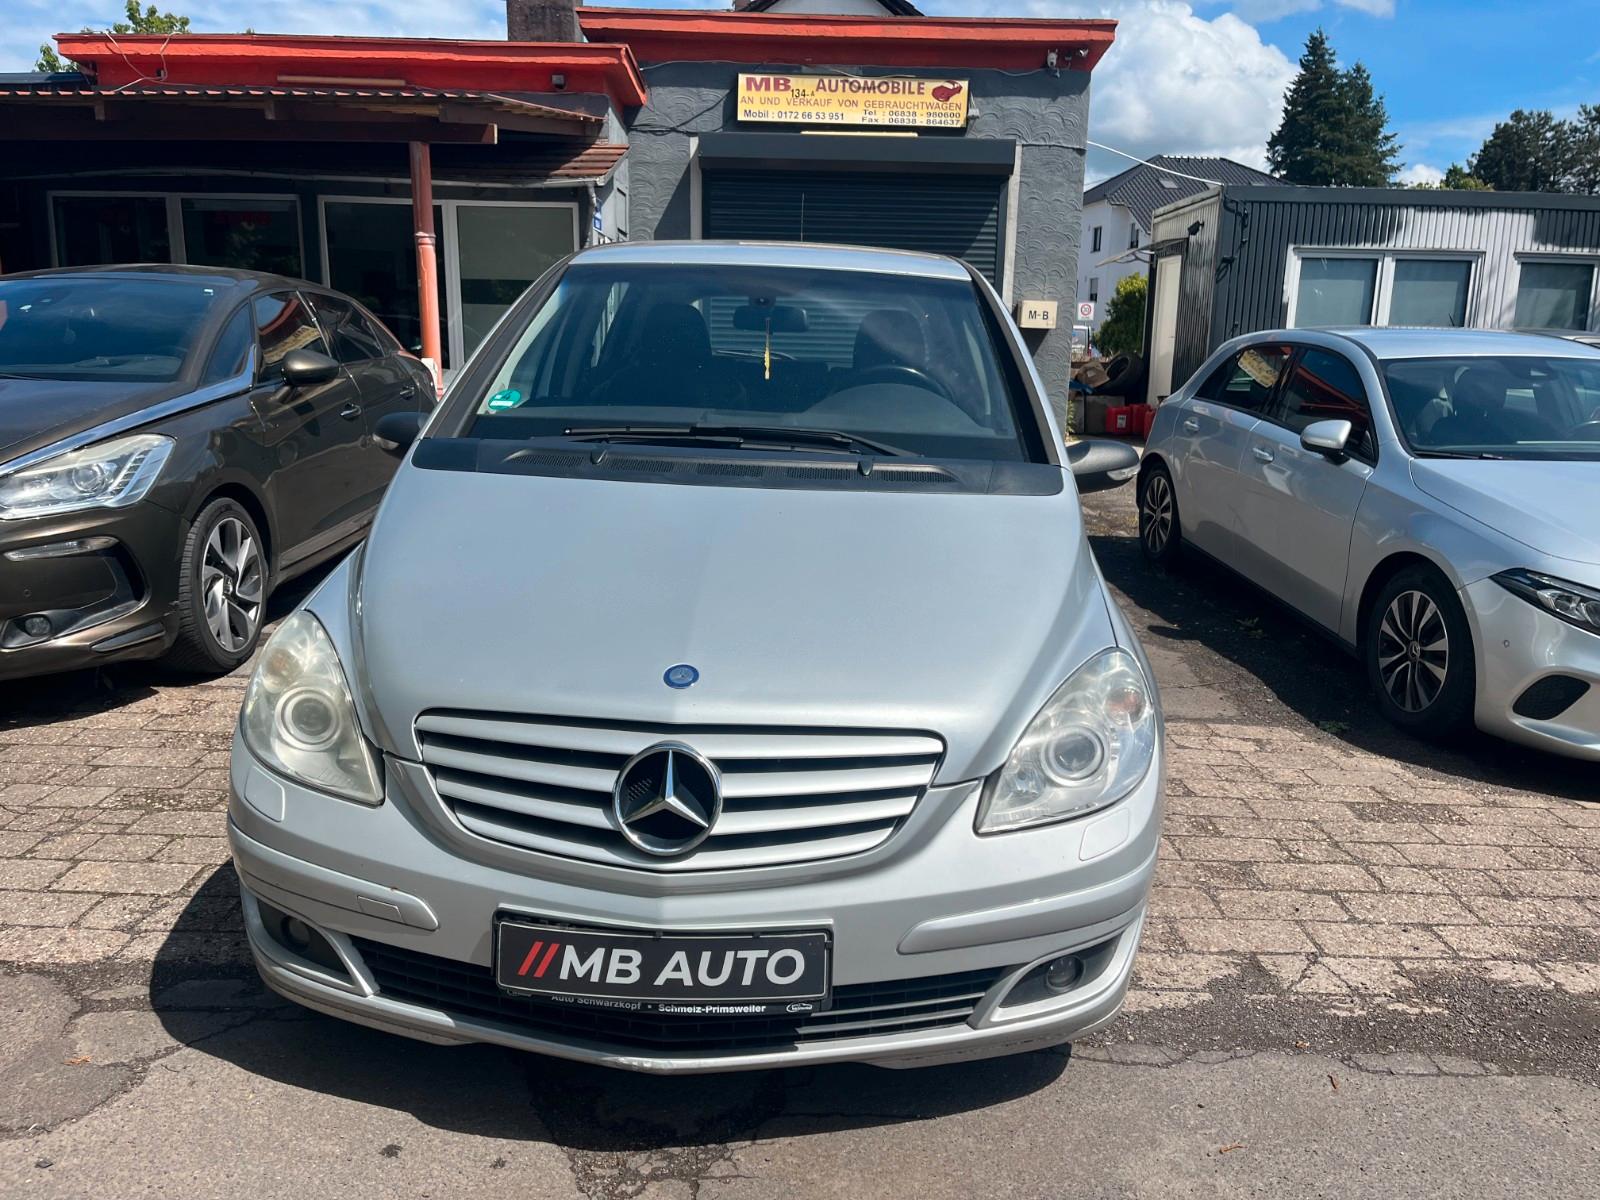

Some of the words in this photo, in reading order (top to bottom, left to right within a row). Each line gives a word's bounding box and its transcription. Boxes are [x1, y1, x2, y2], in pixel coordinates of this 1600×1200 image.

[745, 76, 792, 92] MB
[815, 78, 925, 95] AUTOMOBILE
[740, 95, 754, 105] AN
[760, 97, 780, 106] UND
[786, 97, 832, 107] VERKAUF
[837, 99, 859, 108] VON
[864, 100, 962, 111] GEBRAUCHTWAGEN
[743, 109, 769, 118] Mobil
[777, 110, 799, 120] 0172
[801, 111, 813, 120] 66
[815, 112, 826, 120] 53
[828, 112, 844, 120] 951
[653, 948, 805, 987] AUTO
